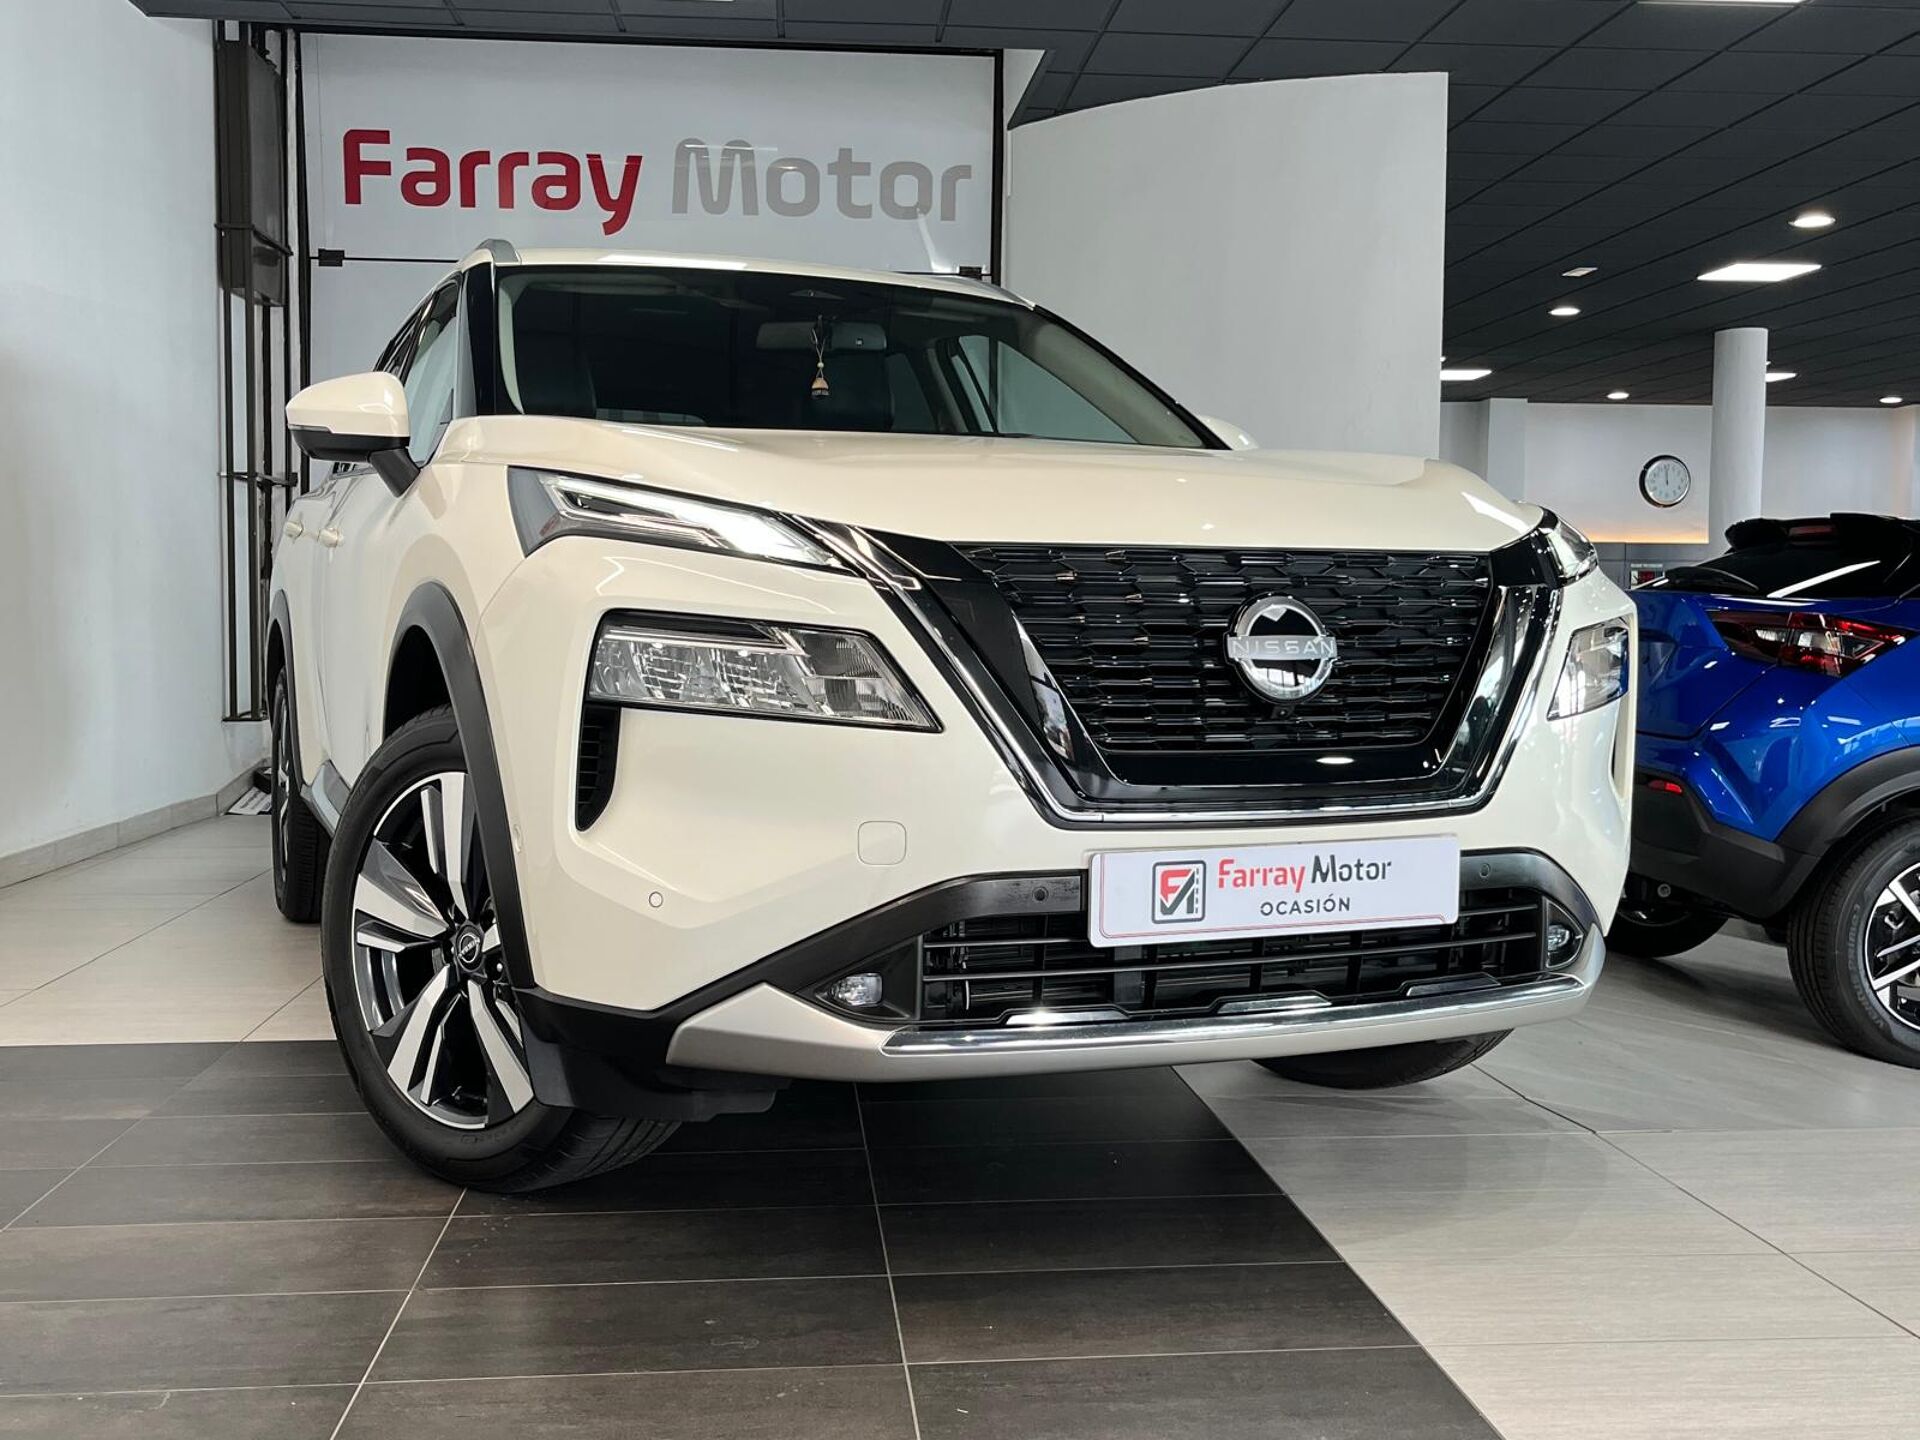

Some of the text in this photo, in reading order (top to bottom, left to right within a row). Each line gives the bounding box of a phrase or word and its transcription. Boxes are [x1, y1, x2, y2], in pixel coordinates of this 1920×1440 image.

[343, 129, 972, 236] Farray Motor
[1231, 639, 1334, 656] NISSAN
[1218, 859, 1305, 893] Farray
[1311, 855, 1392, 884] Motor
[1260, 893, 1351, 917] OCASIÓN
